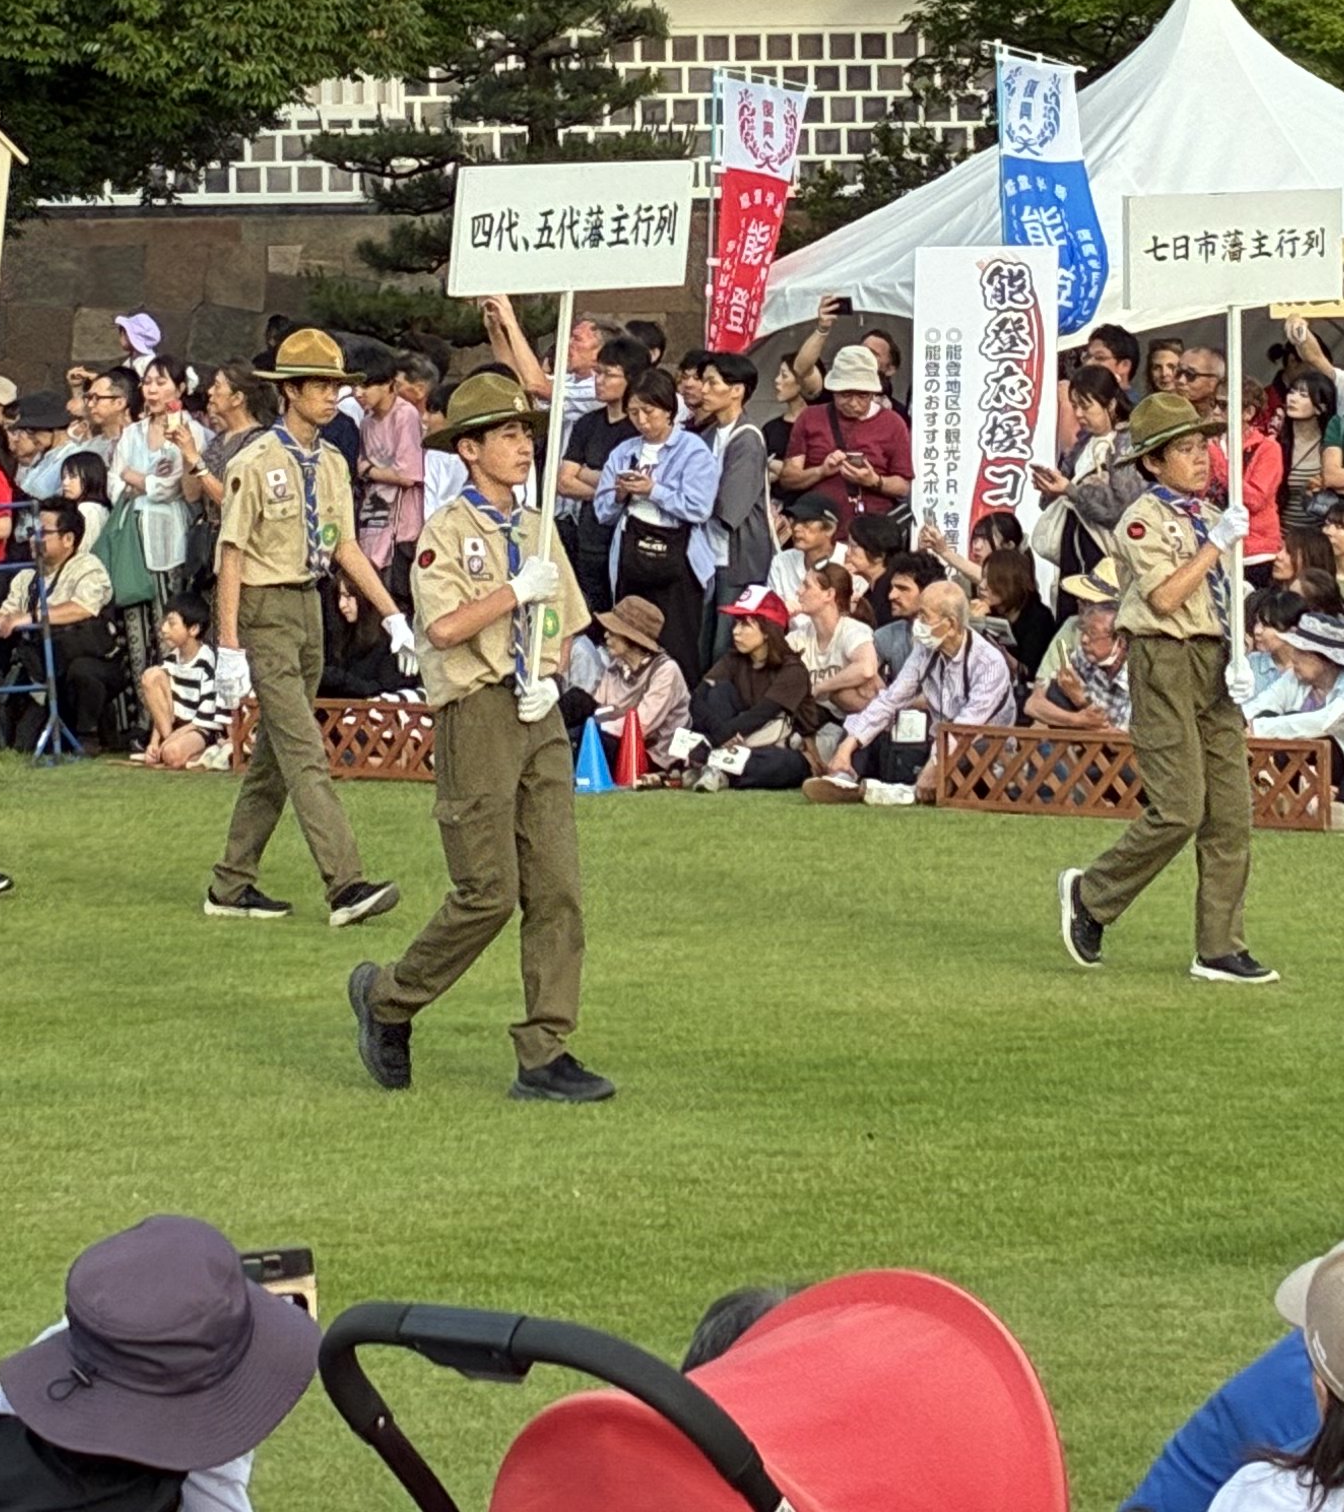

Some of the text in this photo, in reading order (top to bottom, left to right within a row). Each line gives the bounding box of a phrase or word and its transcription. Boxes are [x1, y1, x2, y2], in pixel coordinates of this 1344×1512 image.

[470, 201, 678, 252] 四代、五代藩主行列
[1143, 227, 1326, 264] 七日市藩主行列
